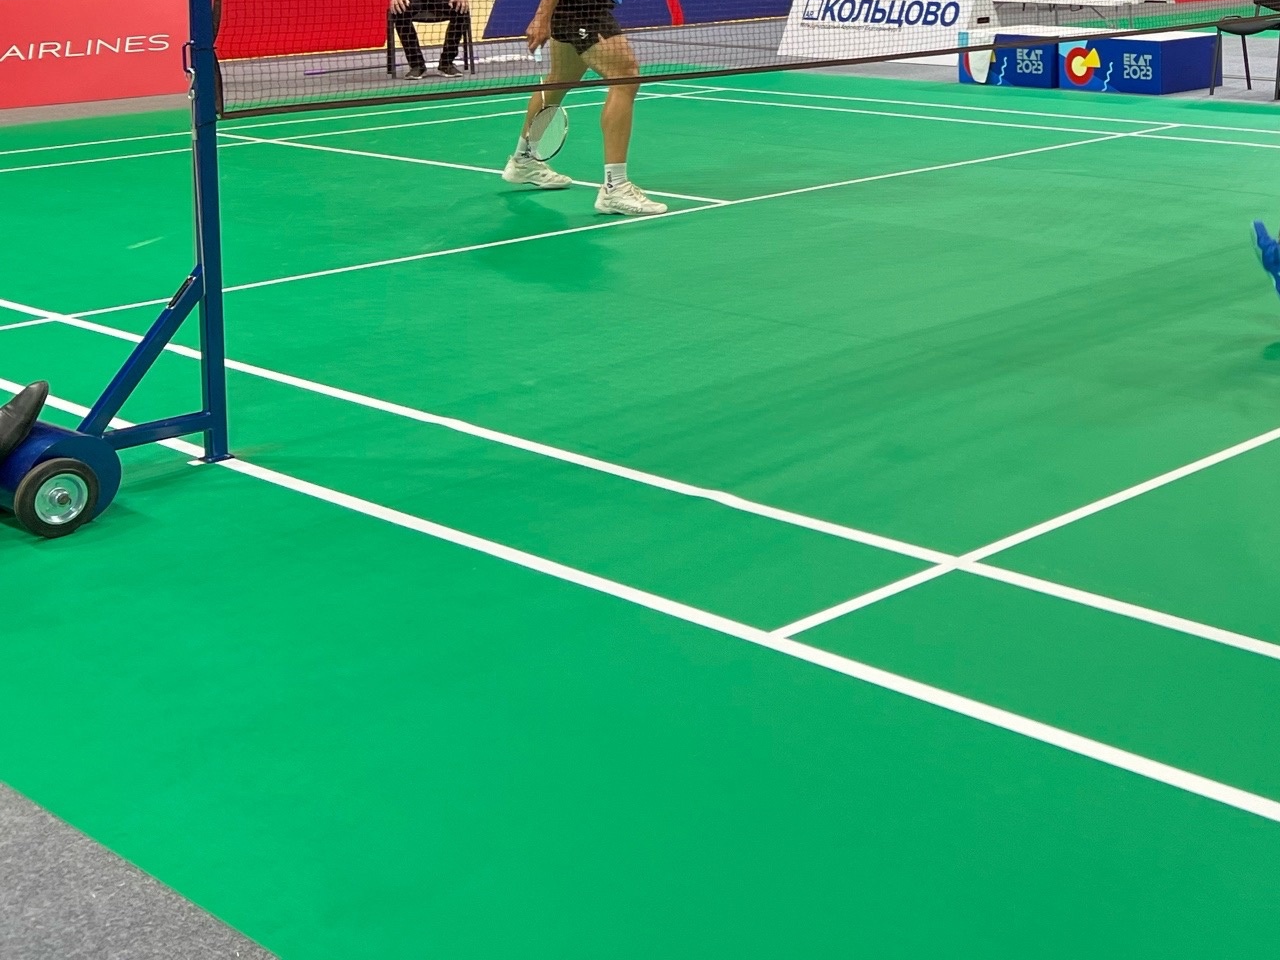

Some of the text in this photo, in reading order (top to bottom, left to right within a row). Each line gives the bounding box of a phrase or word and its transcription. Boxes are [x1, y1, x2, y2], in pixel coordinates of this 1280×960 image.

[0, 34, 170, 62] AIRLINES
[1016, 48, 1043, 61] EKAT
[1123, 53, 1152, 66] EKAT
[1016, 60, 1043, 74] 2023
[1123, 65, 1153, 80] 2023
